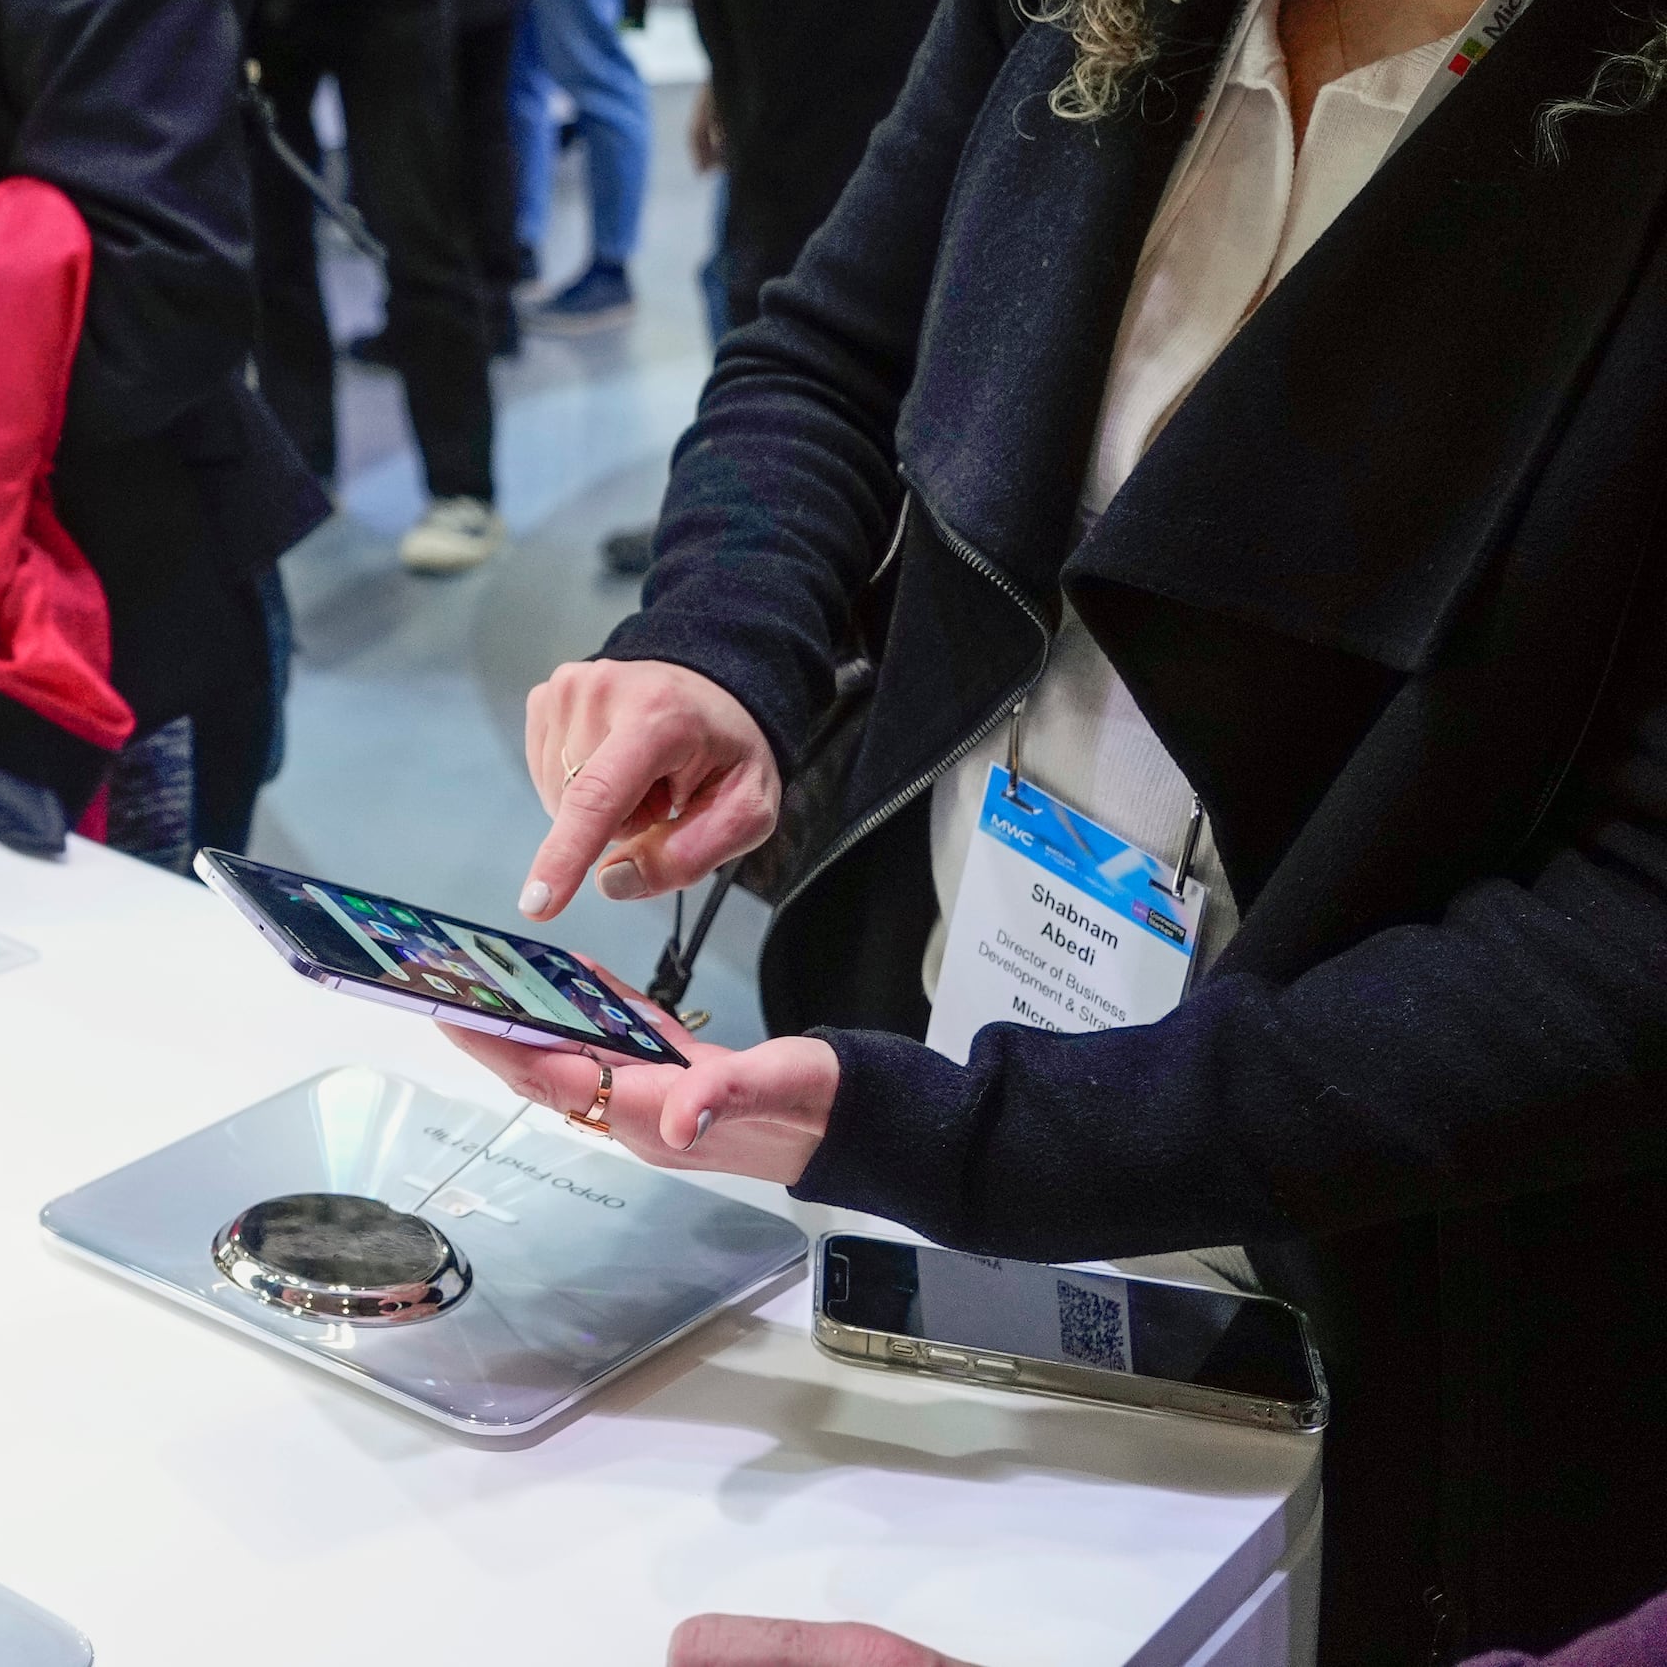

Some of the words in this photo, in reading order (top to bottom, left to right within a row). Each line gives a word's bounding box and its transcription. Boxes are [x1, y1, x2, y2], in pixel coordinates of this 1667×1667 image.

[990, 813, 1035, 847] MWC
[1031, 883, 1119, 950] Shabnam
[1041, 921, 1097, 967] Abedi
[978, 940, 1063, 1005] Development
[1065, 998, 1075, 1013] &
[996, 929, 1047, 970] Director
[1049, 967, 1064, 981] of
[1065, 972, 1127, 1022] Business
[497, 1156, 552, 1182] Find
[551, 1177, 626, 1209] OPPO
